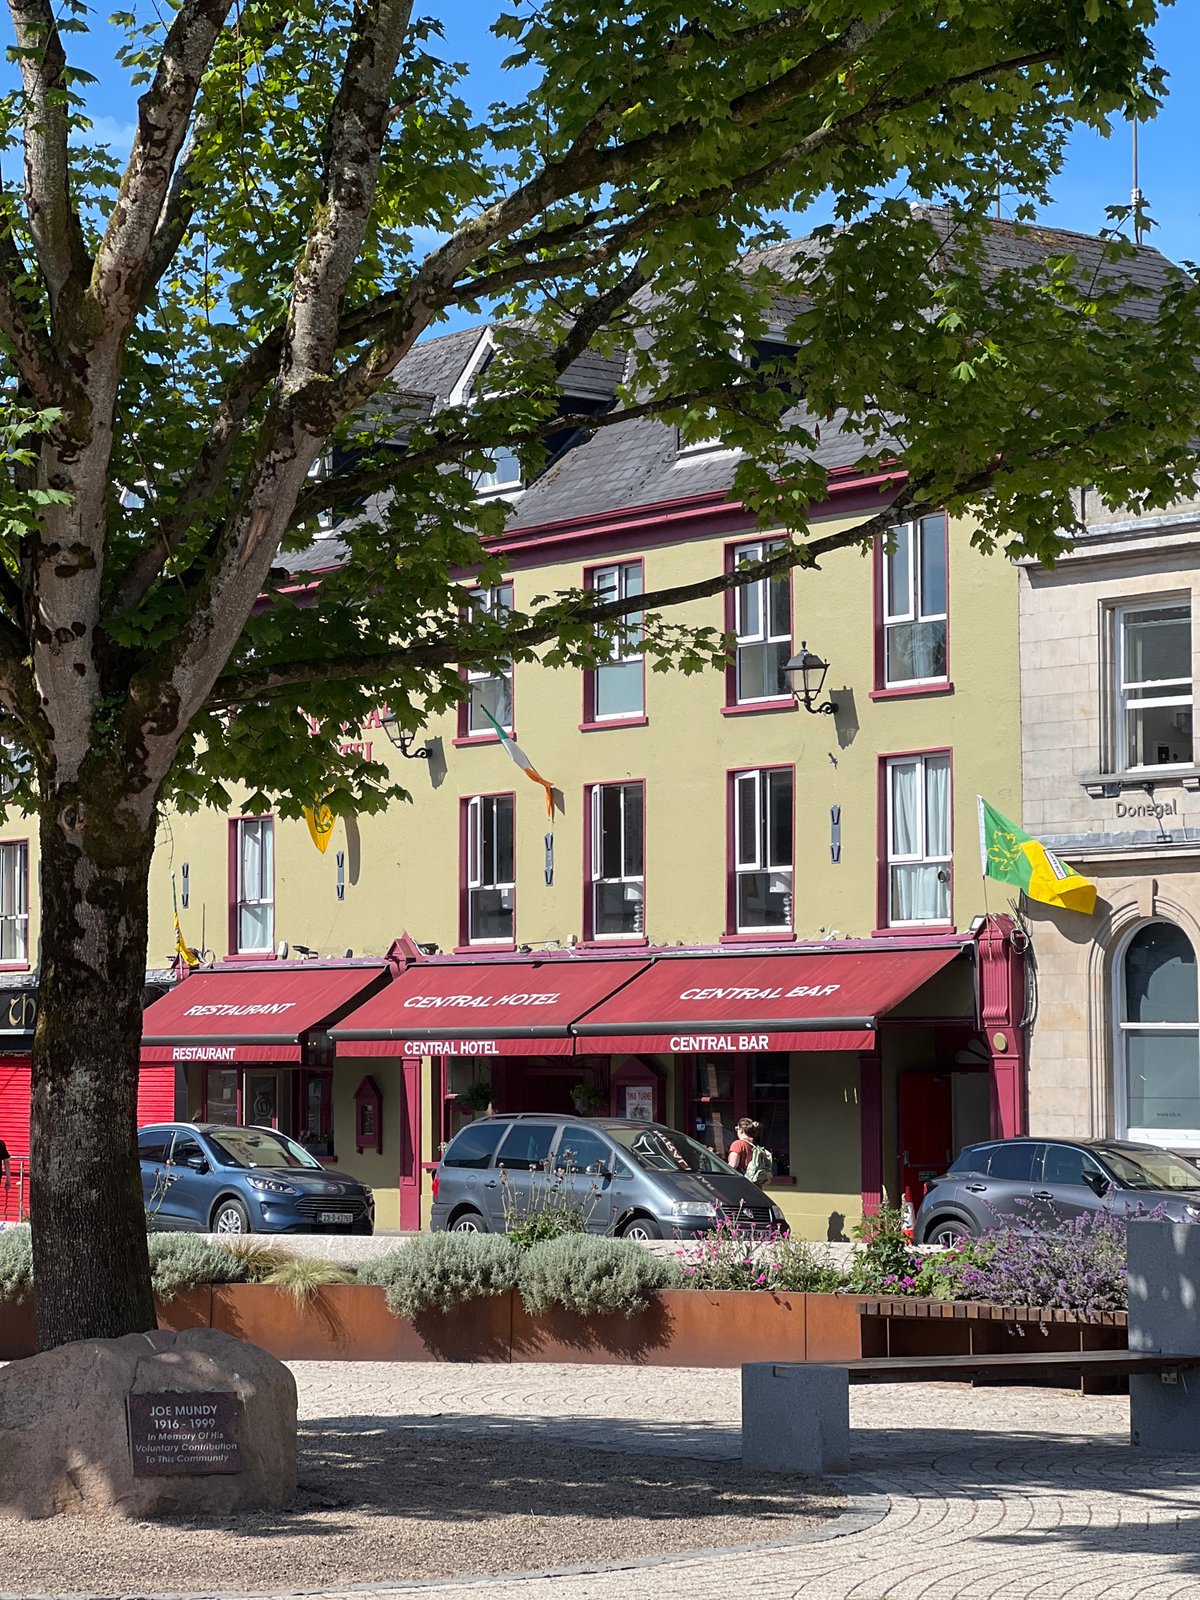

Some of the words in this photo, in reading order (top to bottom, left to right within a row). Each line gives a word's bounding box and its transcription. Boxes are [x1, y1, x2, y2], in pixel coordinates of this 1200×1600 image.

[1115, 797, 1177, 820] Donegal
[679, 987, 784, 1000] CENTRAL
[785, 984, 841, 998] BAR
[403, 994, 493, 1008] CENTRAL
[493, 992, 561, 1006] HOTEL
[183, 1002, 297, 1017] RESTAURANT
[404, 1041, 458, 1055] CENTRAL
[460, 1040, 499, 1054] HOTEL
[670, 1036, 736, 1051] CENTRAL
[739, 1035, 769, 1050] BAR
[172, 1047, 236, 1060] RESTAURANT
[149, 1405, 172, 1417] JOE
[175, 1404, 218, 1416] MUNDY
[154, 1419, 180, 1430] 1916
[190, 1418, 216, 1429] 1999
[147, 1433, 156, 1441] In
[158, 1432, 196, 1441] Memory
[198, 1431, 209, 1440] Of
[211, 1431, 224, 1439] His
[135, 1443, 179, 1453] Voluntary
[181, 1442, 237, 1451] Contribution
[145, 1455, 156, 1464] To
[158, 1454, 174, 1463] This
[176, 1453, 229, 1463] Community
